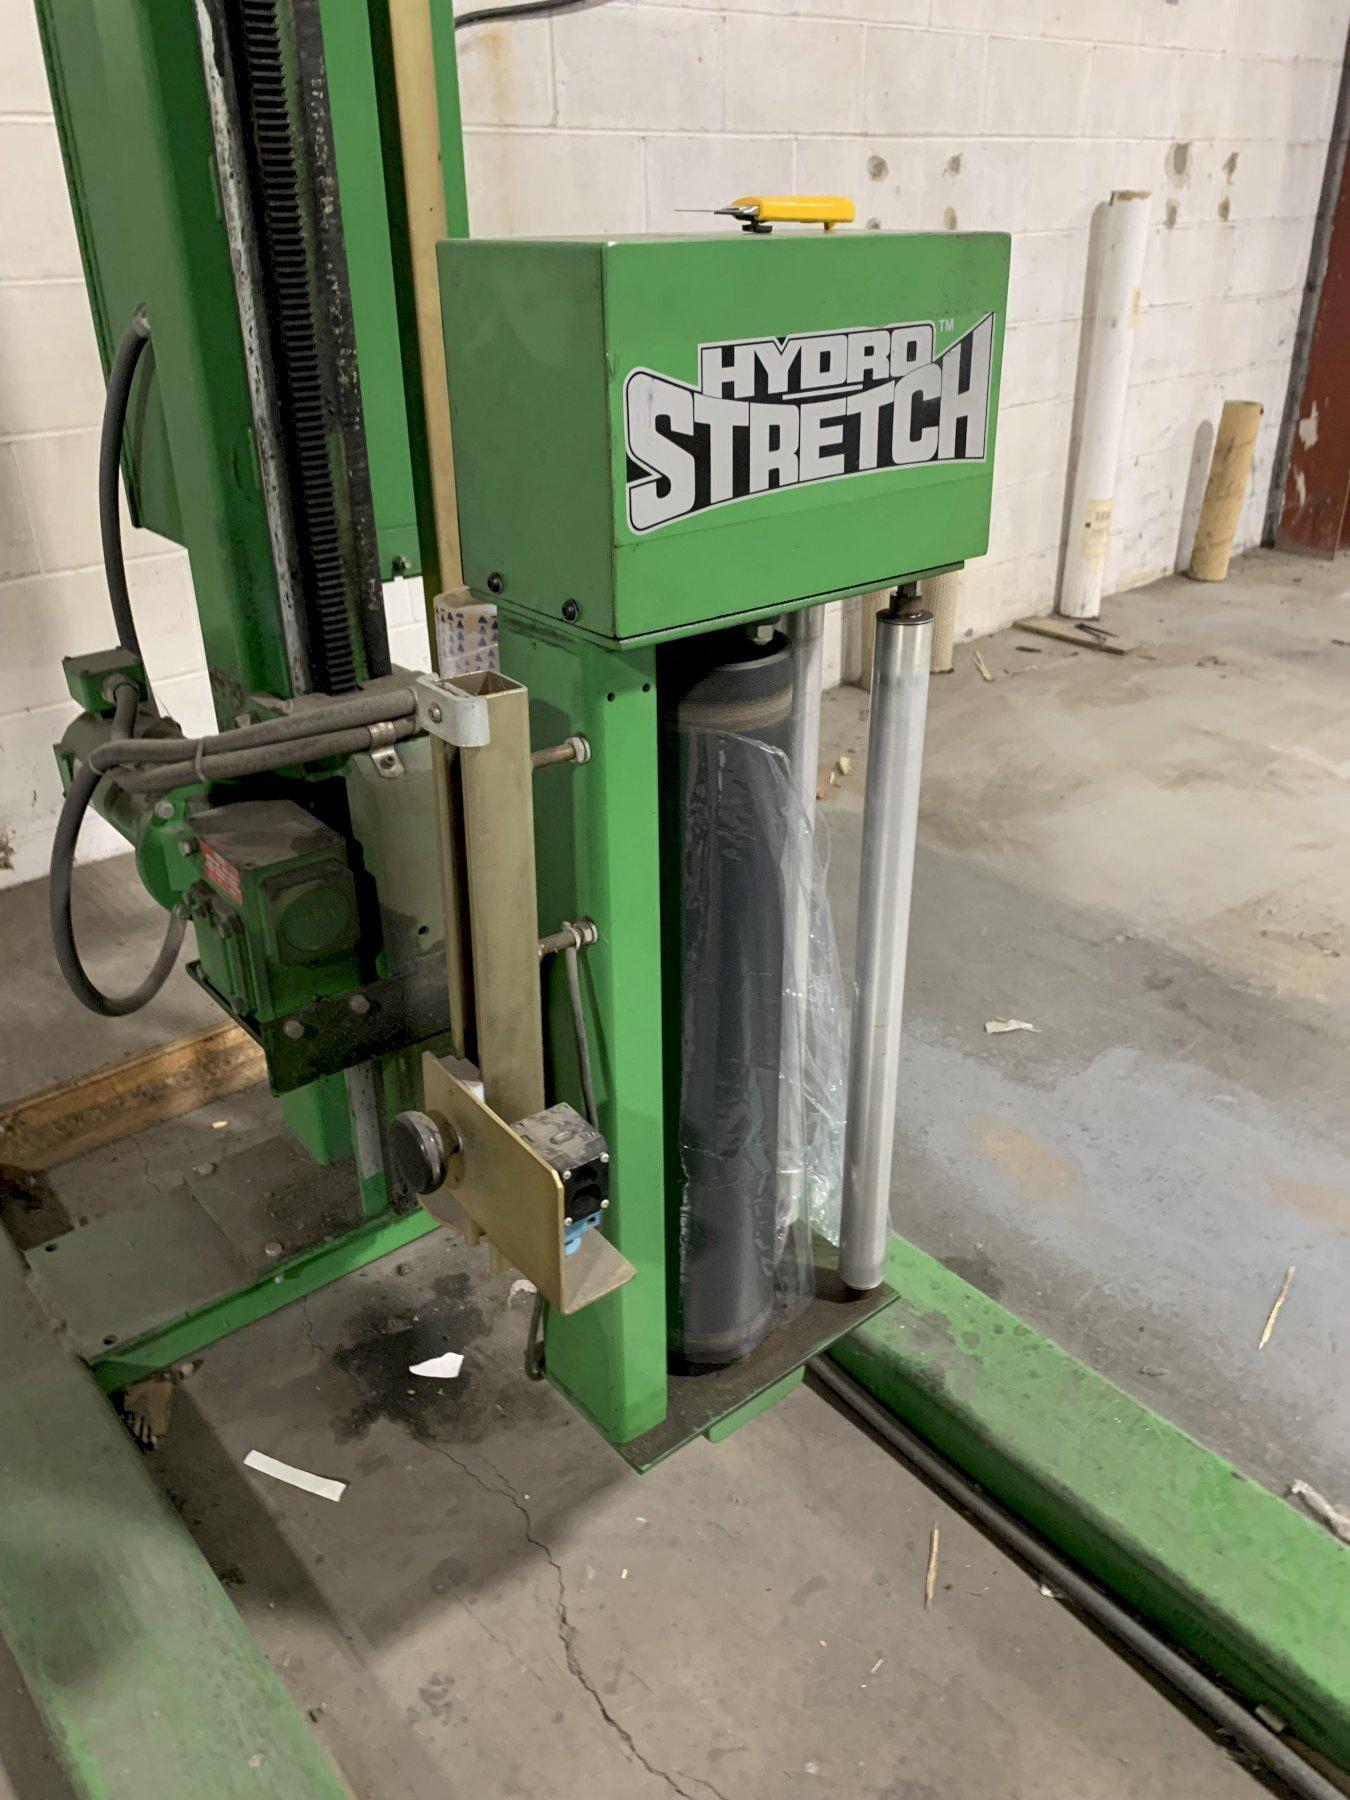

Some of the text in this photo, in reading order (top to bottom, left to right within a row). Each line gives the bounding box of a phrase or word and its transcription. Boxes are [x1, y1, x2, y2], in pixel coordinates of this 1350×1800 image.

[626, 312, 993, 531] STRETCH
[701, 318, 955, 399] HYDRO TM
